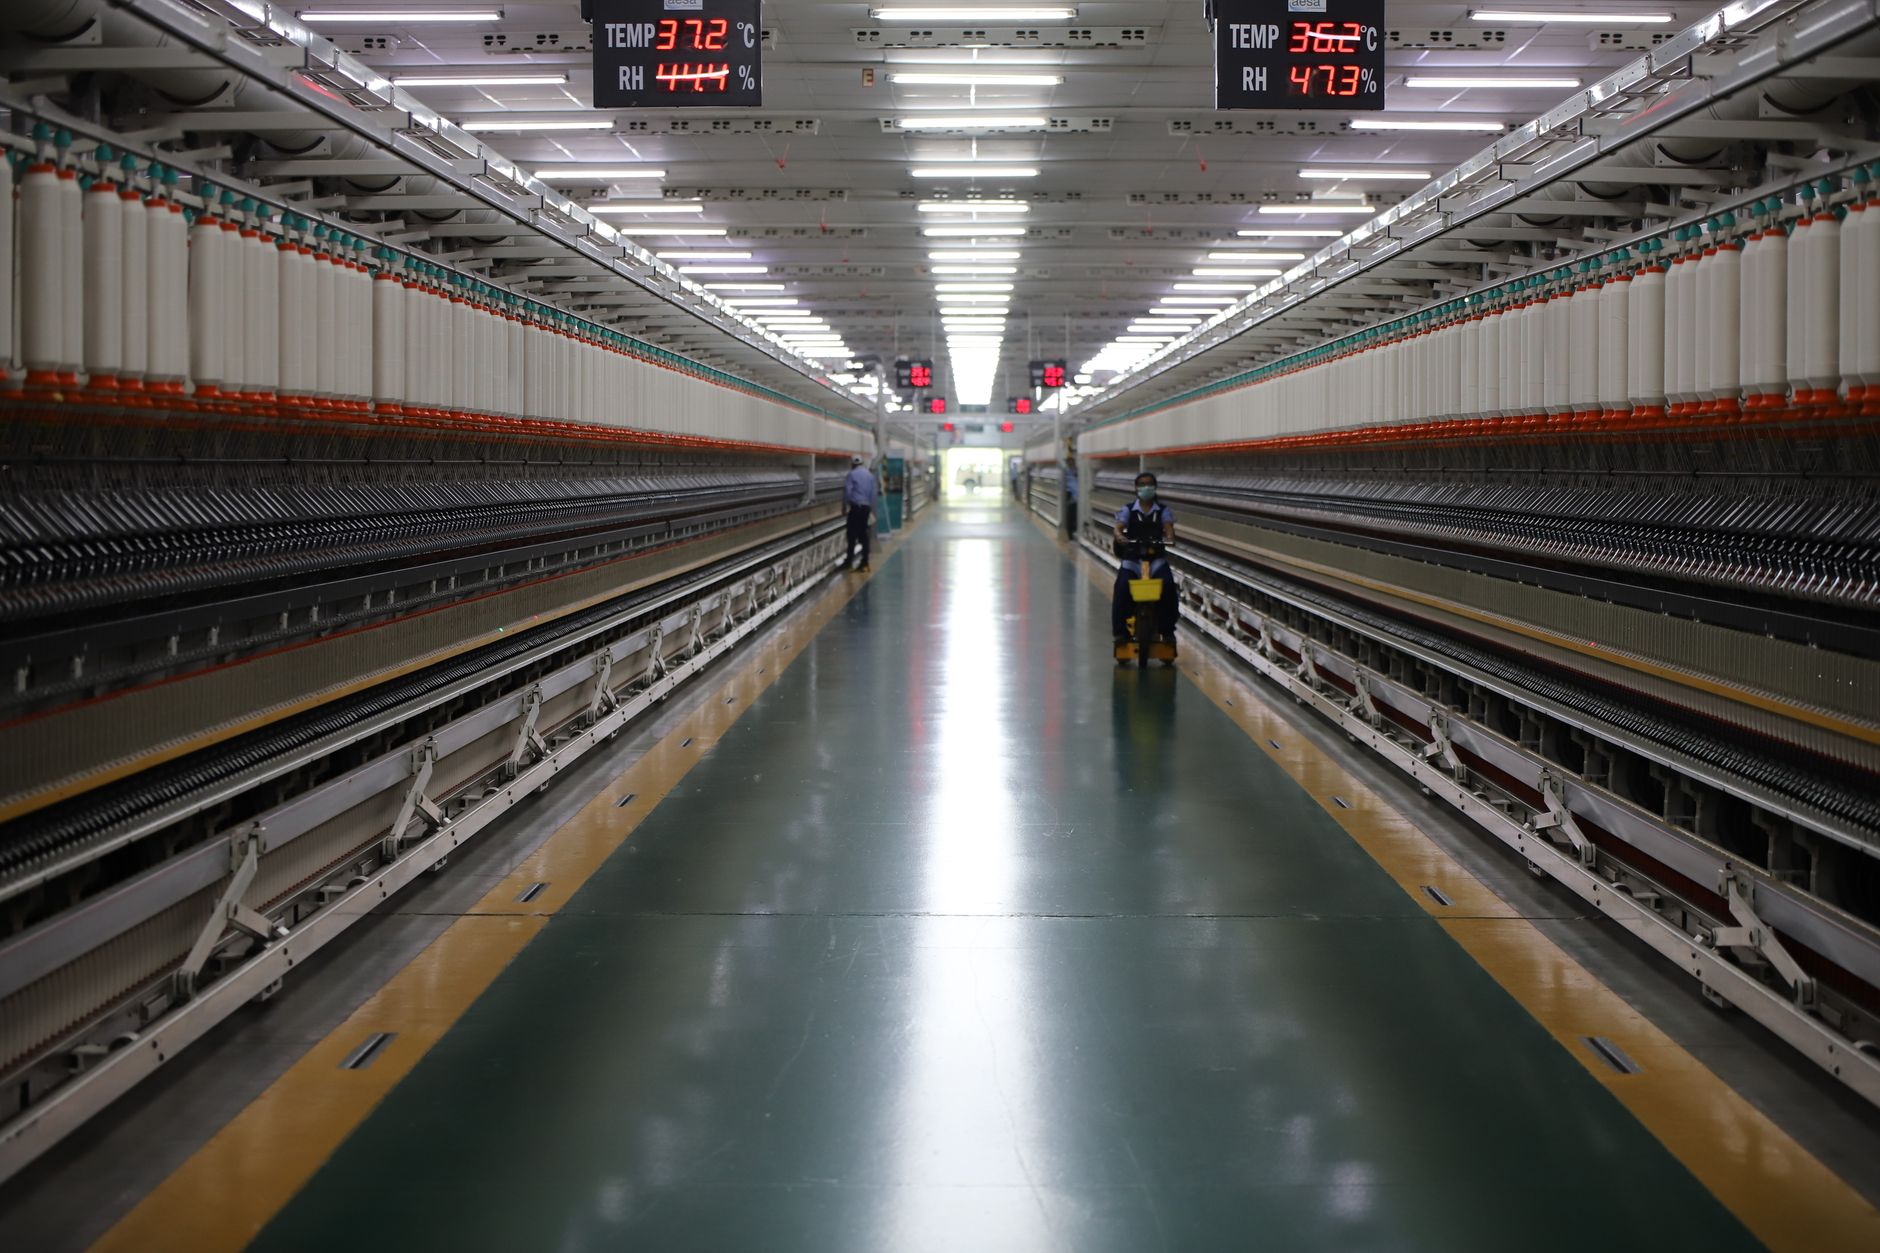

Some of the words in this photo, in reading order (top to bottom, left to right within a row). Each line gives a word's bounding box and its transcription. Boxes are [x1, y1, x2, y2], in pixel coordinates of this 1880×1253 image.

[605, 23, 656, 48] TEMP
[656, 19, 729, 50] 37.2
[736, 22, 755, 48] °C
[1230, 24, 1280, 49] TEMP
[1361, 25, 1378, 52] °C
[618, 66, 644, 91] RH
[738, 65, 755, 91] %
[1242, 66, 1267, 91] RH
[1290, 65, 1361, 96] 47.3
[1361, 68, 1377, 93] %
